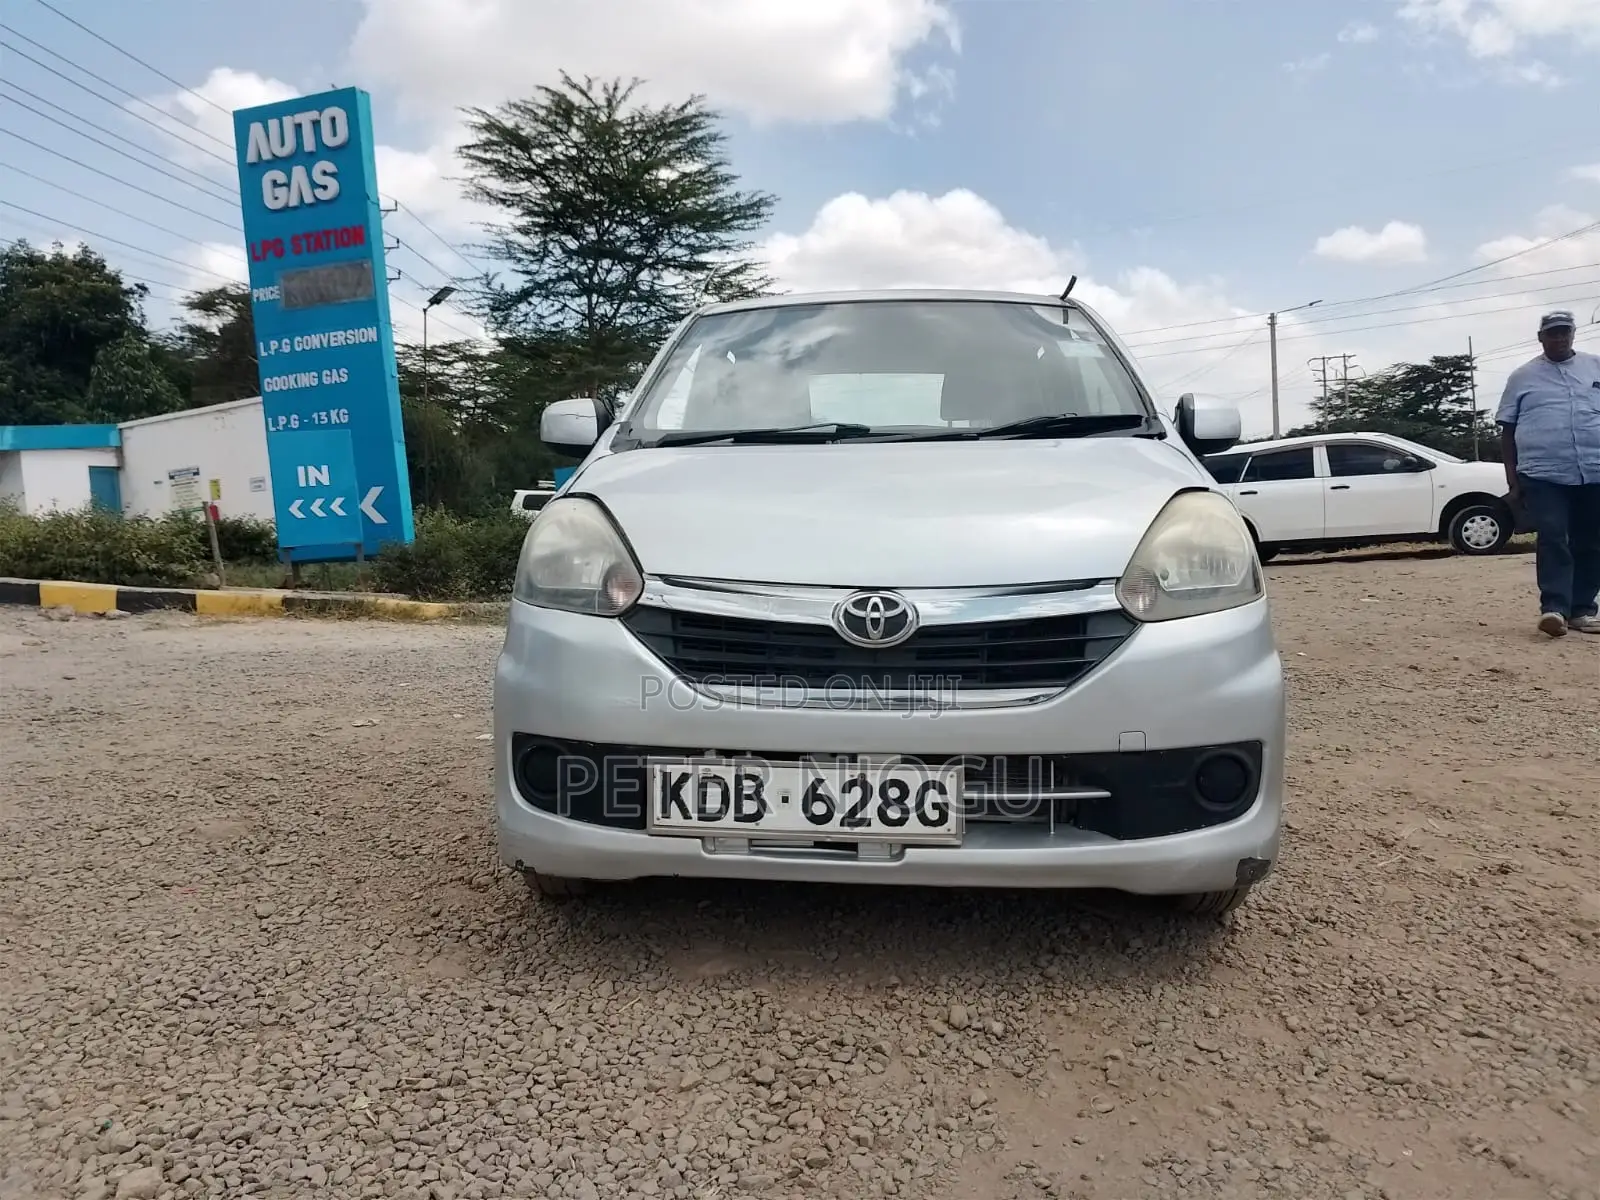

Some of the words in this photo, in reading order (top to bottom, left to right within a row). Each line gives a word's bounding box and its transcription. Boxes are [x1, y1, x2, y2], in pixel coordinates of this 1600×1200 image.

[246, 106, 349, 163] AUTO
[262, 160, 340, 211] GAS
[251, 240, 285, 262] LPG
[292, 225, 364, 255] STATION
[252, 285, 280, 302] PRICE
[295, 327, 377, 351] CONVERSION
[263, 372, 318, 392] COOKING
[322, 368, 349, 385] GAS
[297, 465, 330, 488] IN
[660, 771, 767, 823] KDB
[801, 777, 950, 827] 628G
